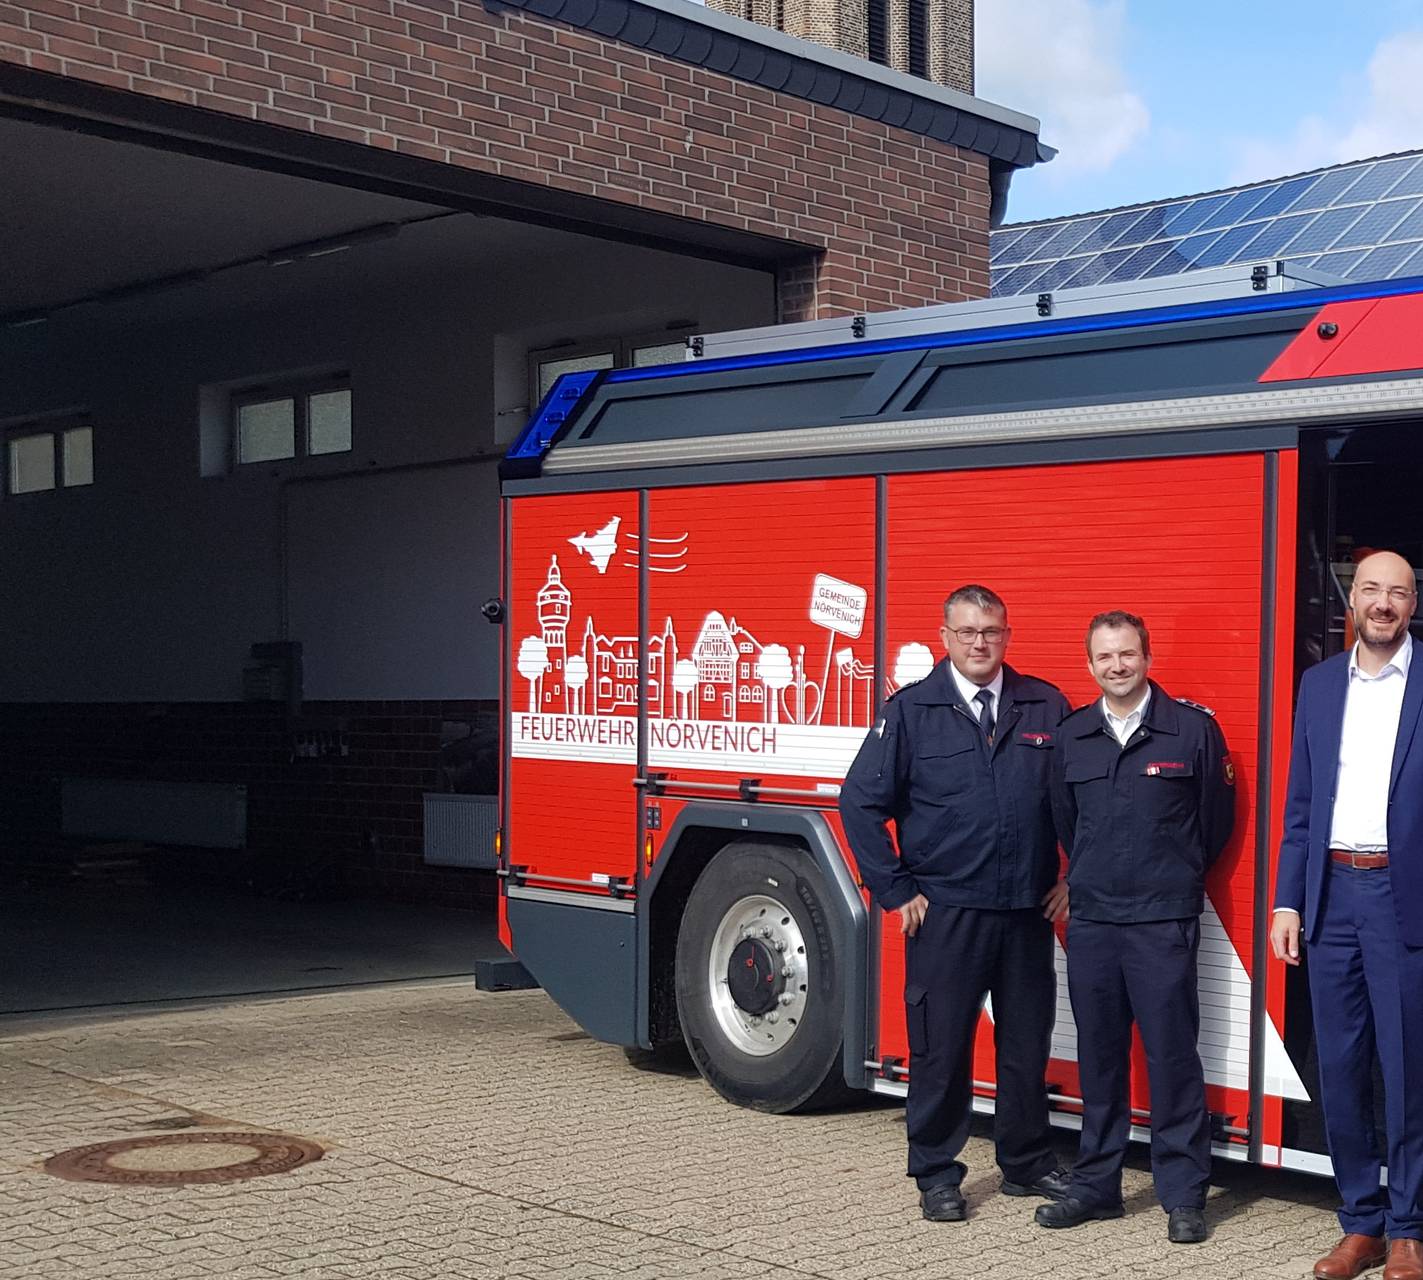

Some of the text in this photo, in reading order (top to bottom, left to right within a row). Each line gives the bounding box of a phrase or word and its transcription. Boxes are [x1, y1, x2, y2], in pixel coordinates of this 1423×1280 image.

[819, 587, 861, 610] GEMEINDE
[814, 600, 861, 626] NÖRVENICH
[520, 715, 777, 754] FEUERWEHR NÖRVENICH
